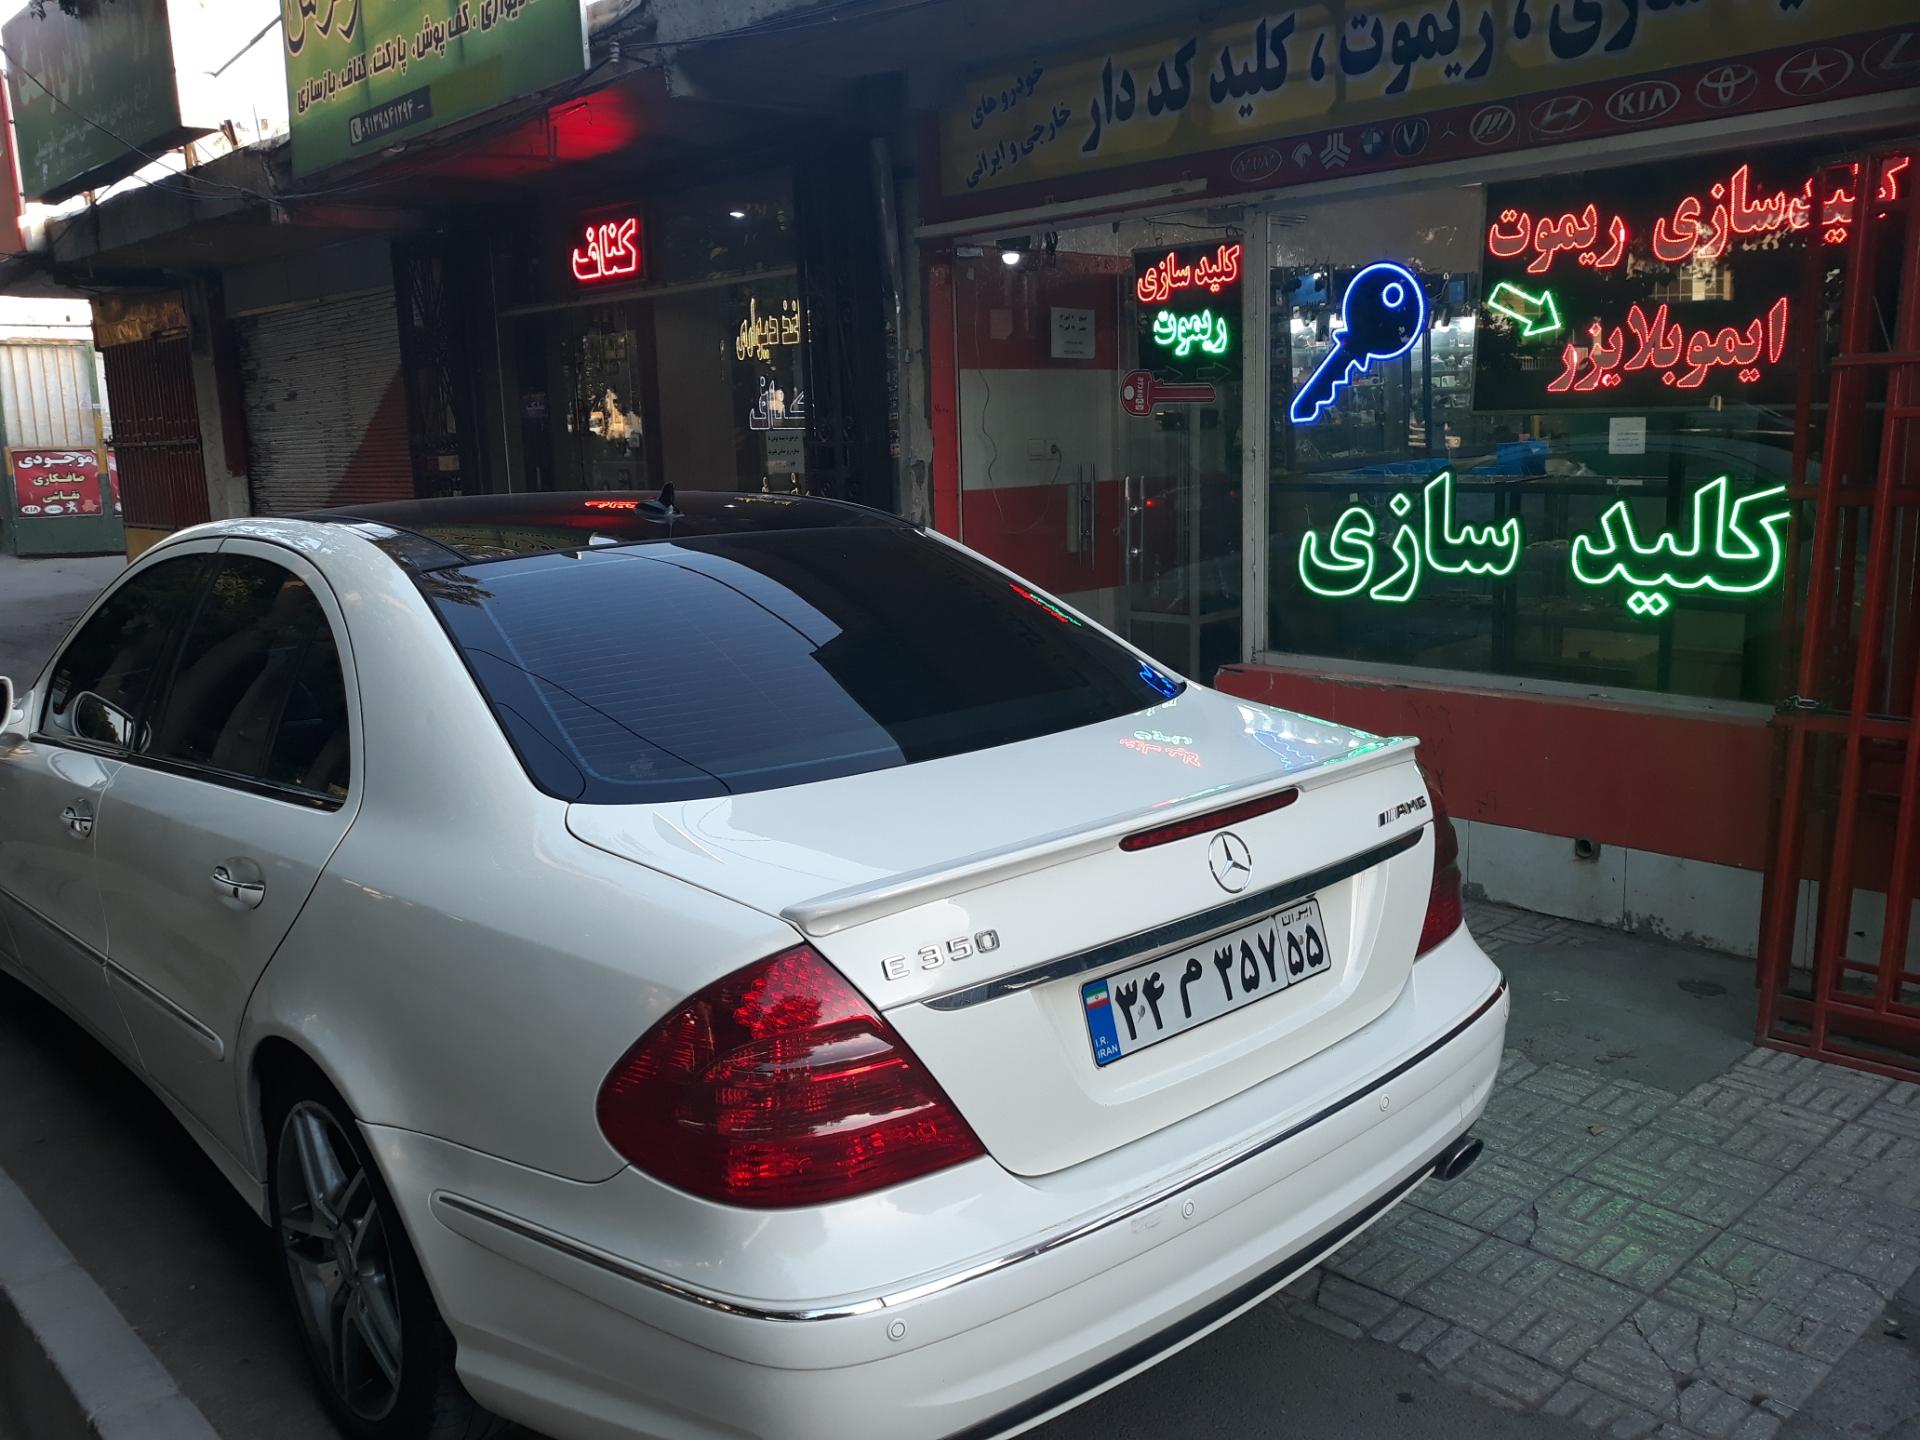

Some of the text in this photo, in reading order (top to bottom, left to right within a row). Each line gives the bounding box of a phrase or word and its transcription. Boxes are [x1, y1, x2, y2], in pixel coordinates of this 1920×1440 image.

[448, 2, 469, 38] کف
[1147, 37, 1197, 117] کد
[1209, 10, 1296, 118] کلید
[297, 70, 336, 114] بازسازی
[1081, 56, 1137, 153] دار
[1617, 88, 1668, 116] KIA
[966, 101, 1072, 188] خارجی و ایرانی
[1488, 204, 1626, 273] ریموت
[1653, 163, 1786, 260] سازی
[572, 217, 637, 280] کناف
[1136, 244, 1241, 302] کلید سازی
[735, 297, 780, 361] دیواری
[1152, 308, 1229, 357] ریموت
[1547, 296, 1788, 392] ایموبلایزر
[18, 454, 94, 469] موجودی
[32, 472, 86, 487] صافکاری
[42, 490, 81, 504] نقاشی
[1298, 471, 1791, 616] کلید سازی
[1395, 795, 1428, 820] AMG
[1281, 905, 1313, 927] ایران
[880, 928, 1001, 981] E 350
[1286, 923, 1324, 977] ۵۵
[1096, 1044, 1120, 1060] IRAN
